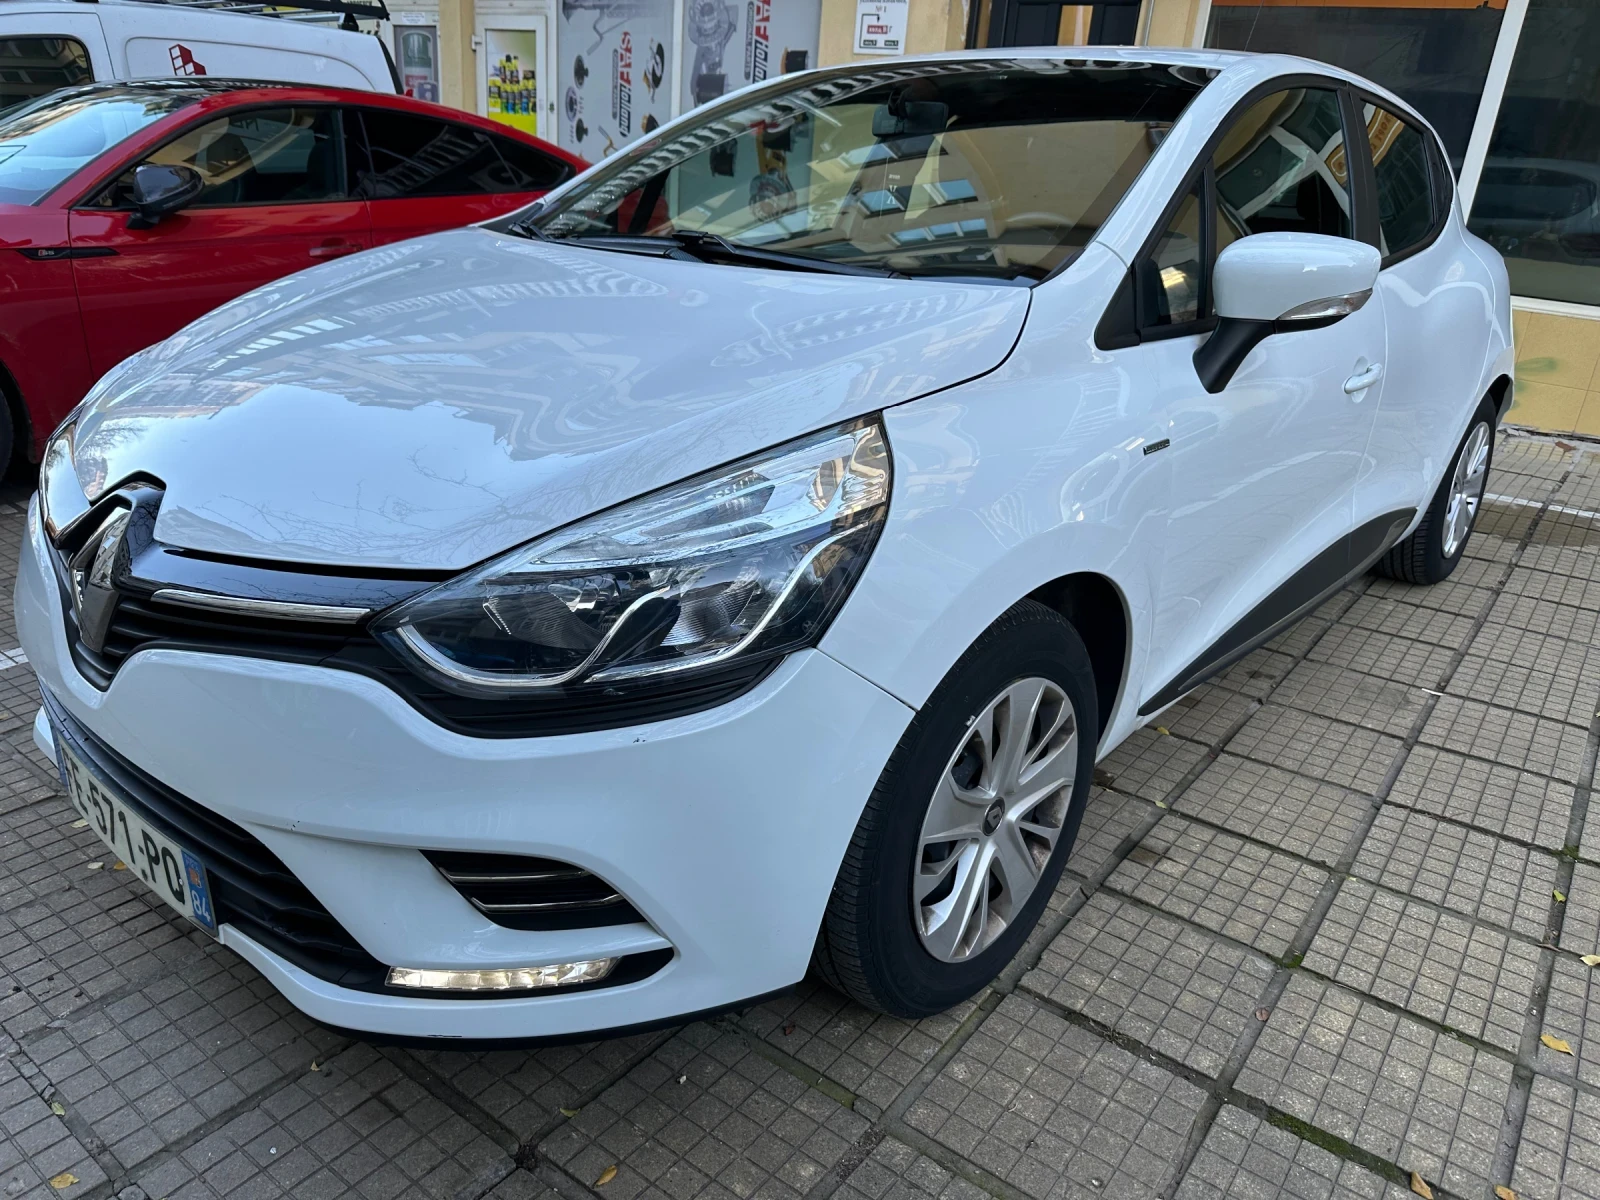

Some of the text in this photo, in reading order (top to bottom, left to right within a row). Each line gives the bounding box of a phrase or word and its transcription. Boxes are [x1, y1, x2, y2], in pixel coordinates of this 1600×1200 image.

[755, 0, 771, 41] AF
[619, 31, 633, 86] SAF
[191, 889, 212, 923] 84
